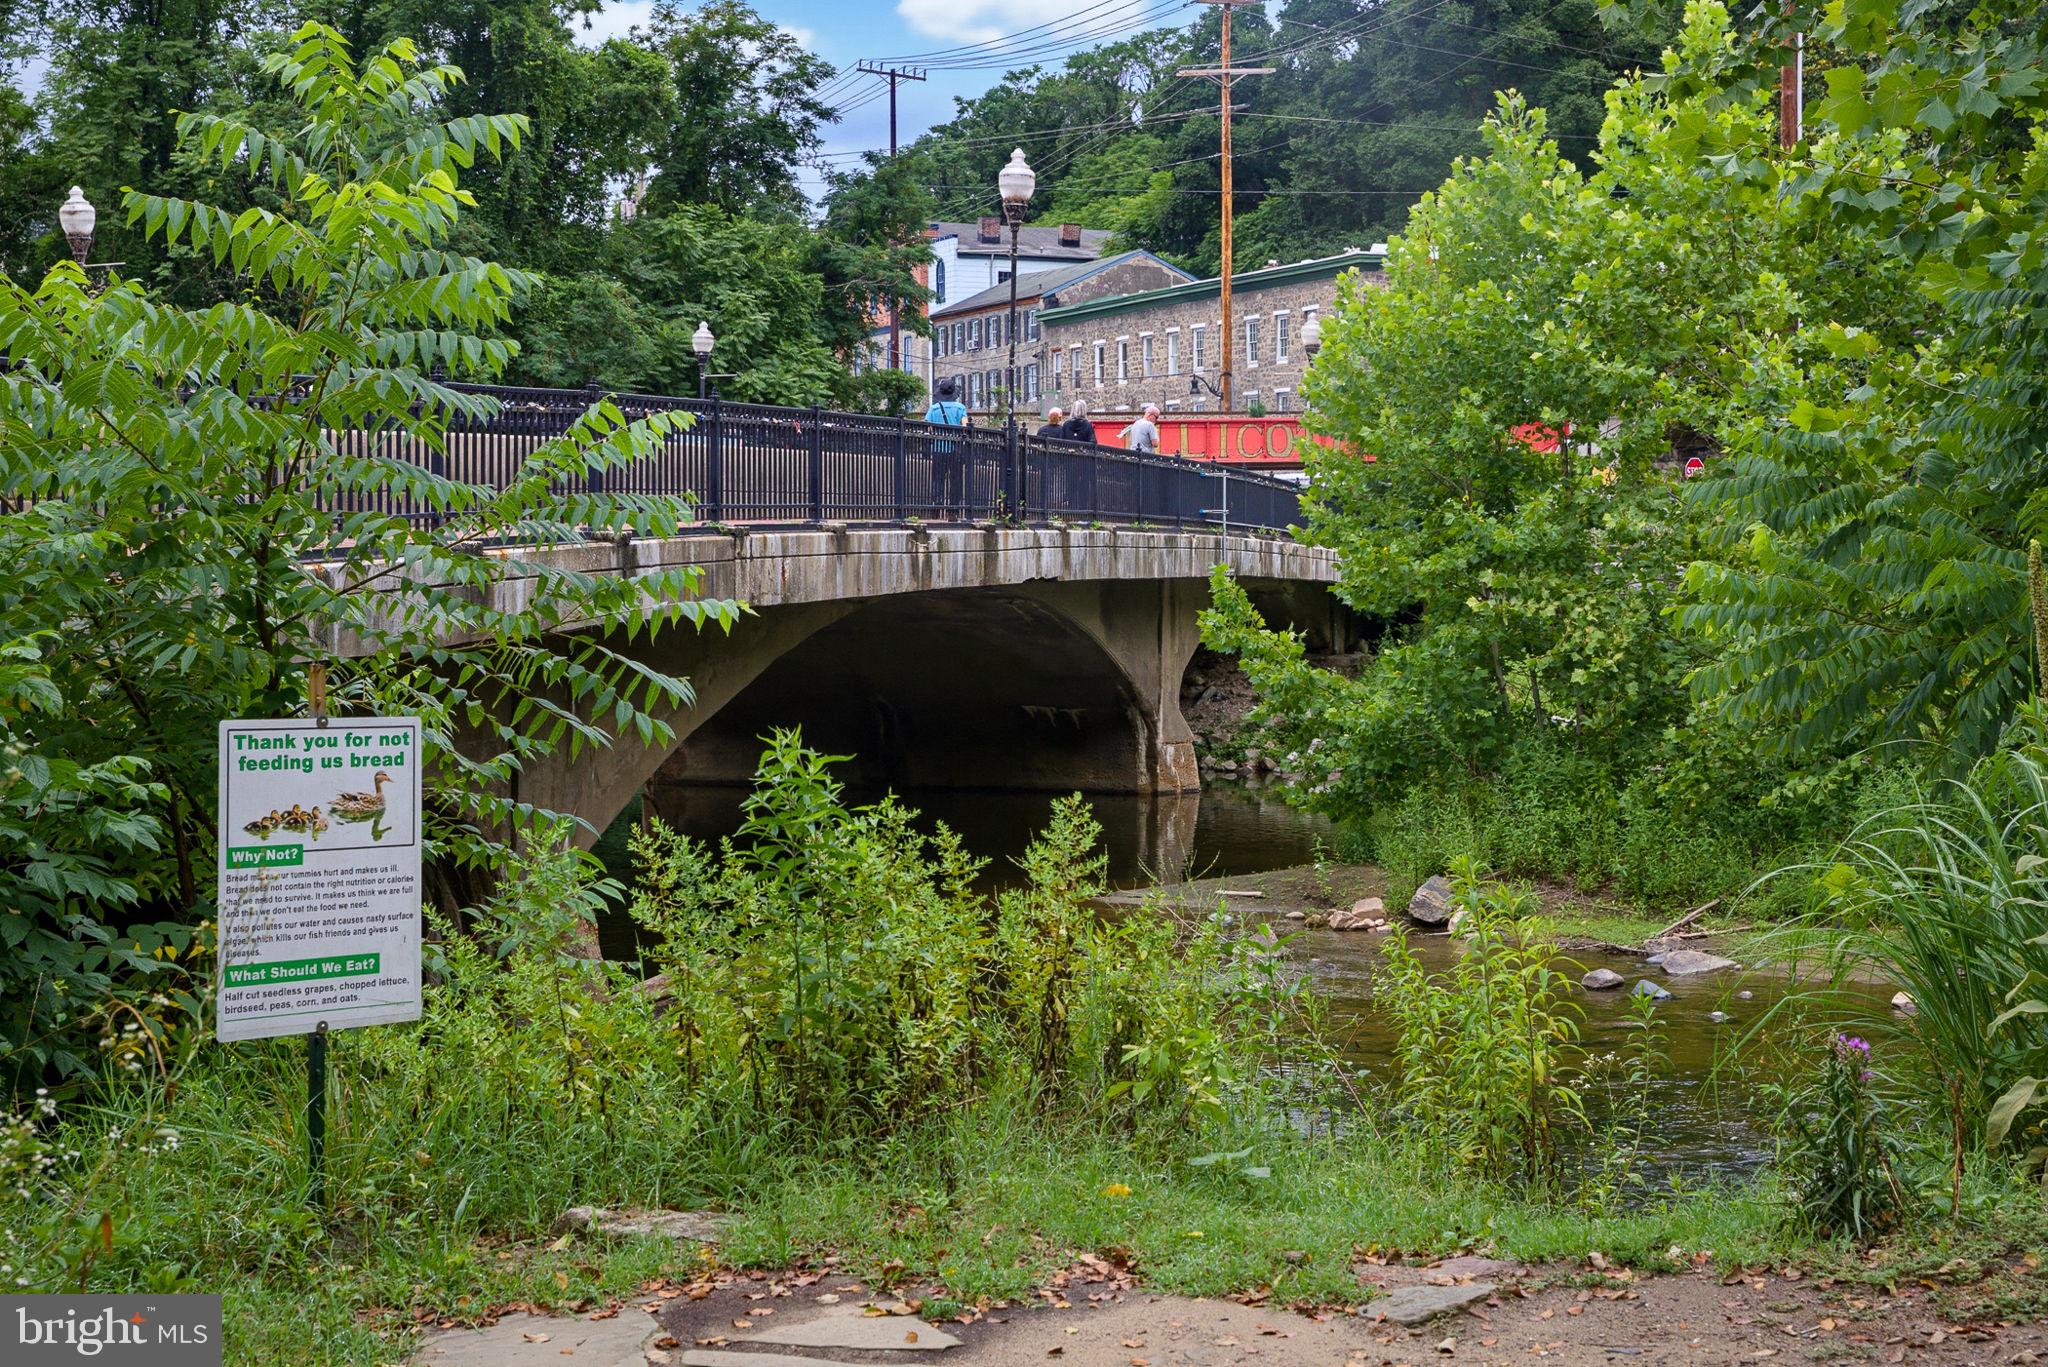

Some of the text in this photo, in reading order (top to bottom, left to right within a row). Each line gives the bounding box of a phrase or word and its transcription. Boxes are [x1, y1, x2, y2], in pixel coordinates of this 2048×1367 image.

[233, 732, 410, 751] Thank you for not
[238, 752, 404, 773] feeding us bread
[232, 848, 298, 864] Why Not?
[226, 874, 248, 882] Bread
[275, 872, 289, 880] ur
[290, 870, 322, 878] tummies
[324, 868, 338, 876] hurt
[340, 867, 354, 876] and
[356, 866, 378, 874] makes
[226, 886, 248, 894] Bread
[284, 882, 312, 890] contain
[314, 880, 325, 888] the
[327, 879, 344, 889] right
[346, 877, 376, 886] nutrition
[387, 875, 414, 884] calories
[284, 894, 314, 902] survive.
[322, 891, 345, 900] makes
[358, 888, 376, 896] think
[402, 886, 414, 894] full
[272, 906, 292, 914] don't
[350, 900, 370, 909] need.
[233, 924, 250, 933] also
[252, 922, 282, 932] pollutes
[300, 920, 320, 928] water
[338, 916, 364, 925] causes
[366, 914, 385, 923] nasty
[388, 912, 414, 920] surface
[276, 934, 292, 942] kills
[308, 930, 322, 939] fish
[325, 928, 351, 938] friends
[352, 927, 366, 936] and
[368, 926, 388, 936] gives
[230, 958, 375, 982] What Should We Eat?
[224, 992, 243, 1002] Half
[246, 990, 260, 1000] cut
[263, 987, 302, 998] seedless
[340, 978, 376, 990] chopped
[224, 1002, 267, 1014] birdseed,
[270, 1001, 294, 1012] peas,
[322, 995, 338, 1004] and
[340, 994, 360, 1003] oats.
